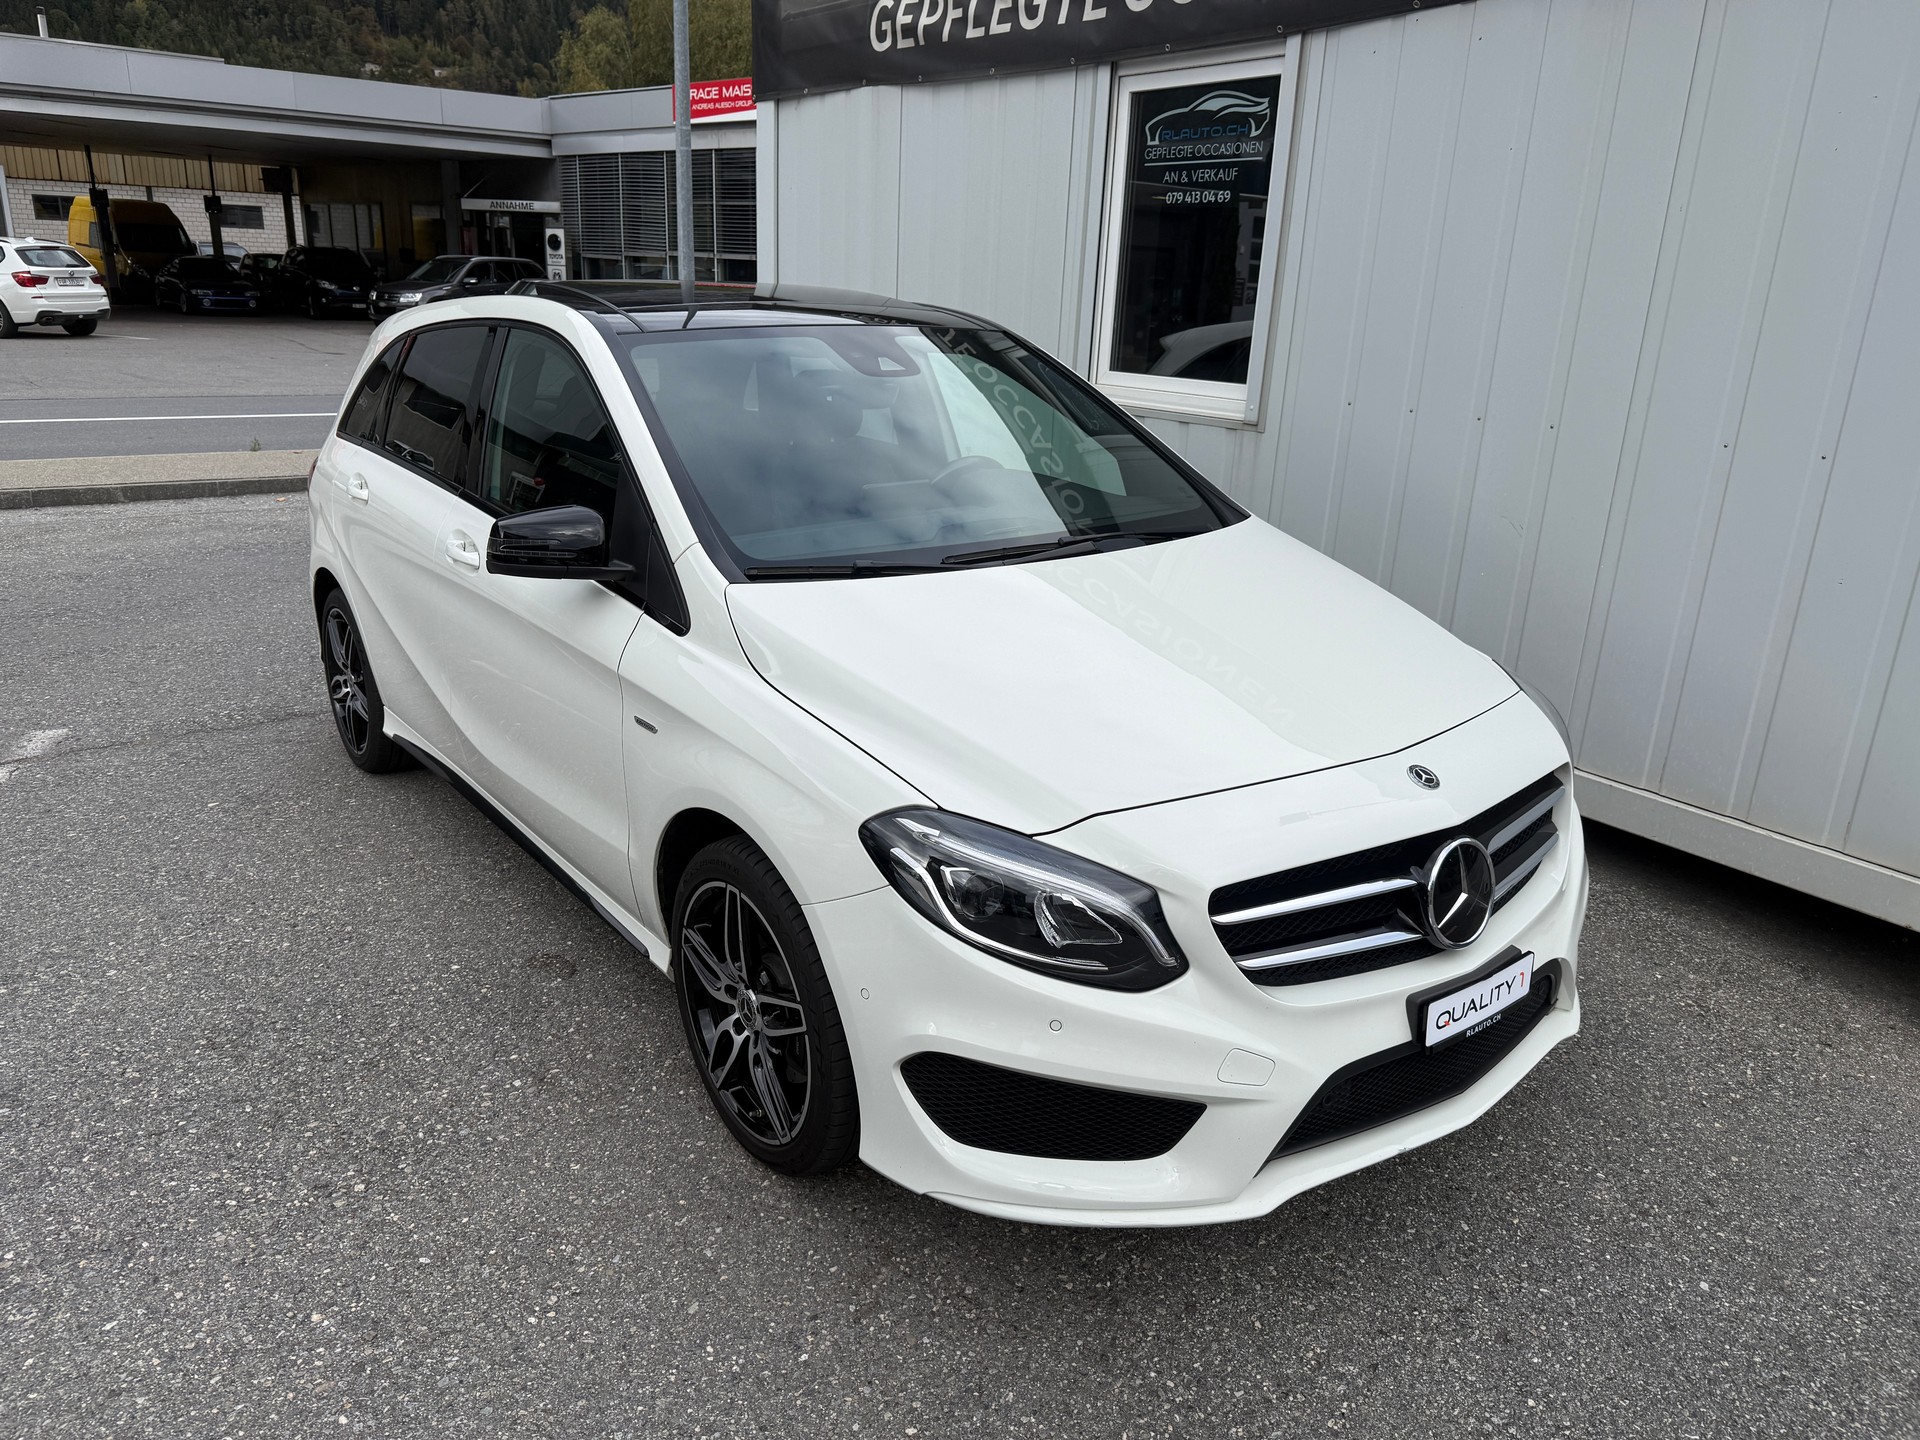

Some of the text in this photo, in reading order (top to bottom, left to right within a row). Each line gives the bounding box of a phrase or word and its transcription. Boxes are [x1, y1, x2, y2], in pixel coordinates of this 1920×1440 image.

[690, 84, 752, 100] RAGE MAIS
[1162, 124, 1248, 140] RLAUTO.CH
[1144, 141, 1263, 160] GEPFLEGTE OCCASIONEN
[1163, 167, 1239, 183] AN & VERKAUF
[1166, 190, 1231, 204] 079 413 04 69
[490, 201, 534, 210] ANNAHME
[1435, 971, 1525, 1030] QUALITY 1
[1466, 1013, 1502, 1038] RLAUTO.CH
